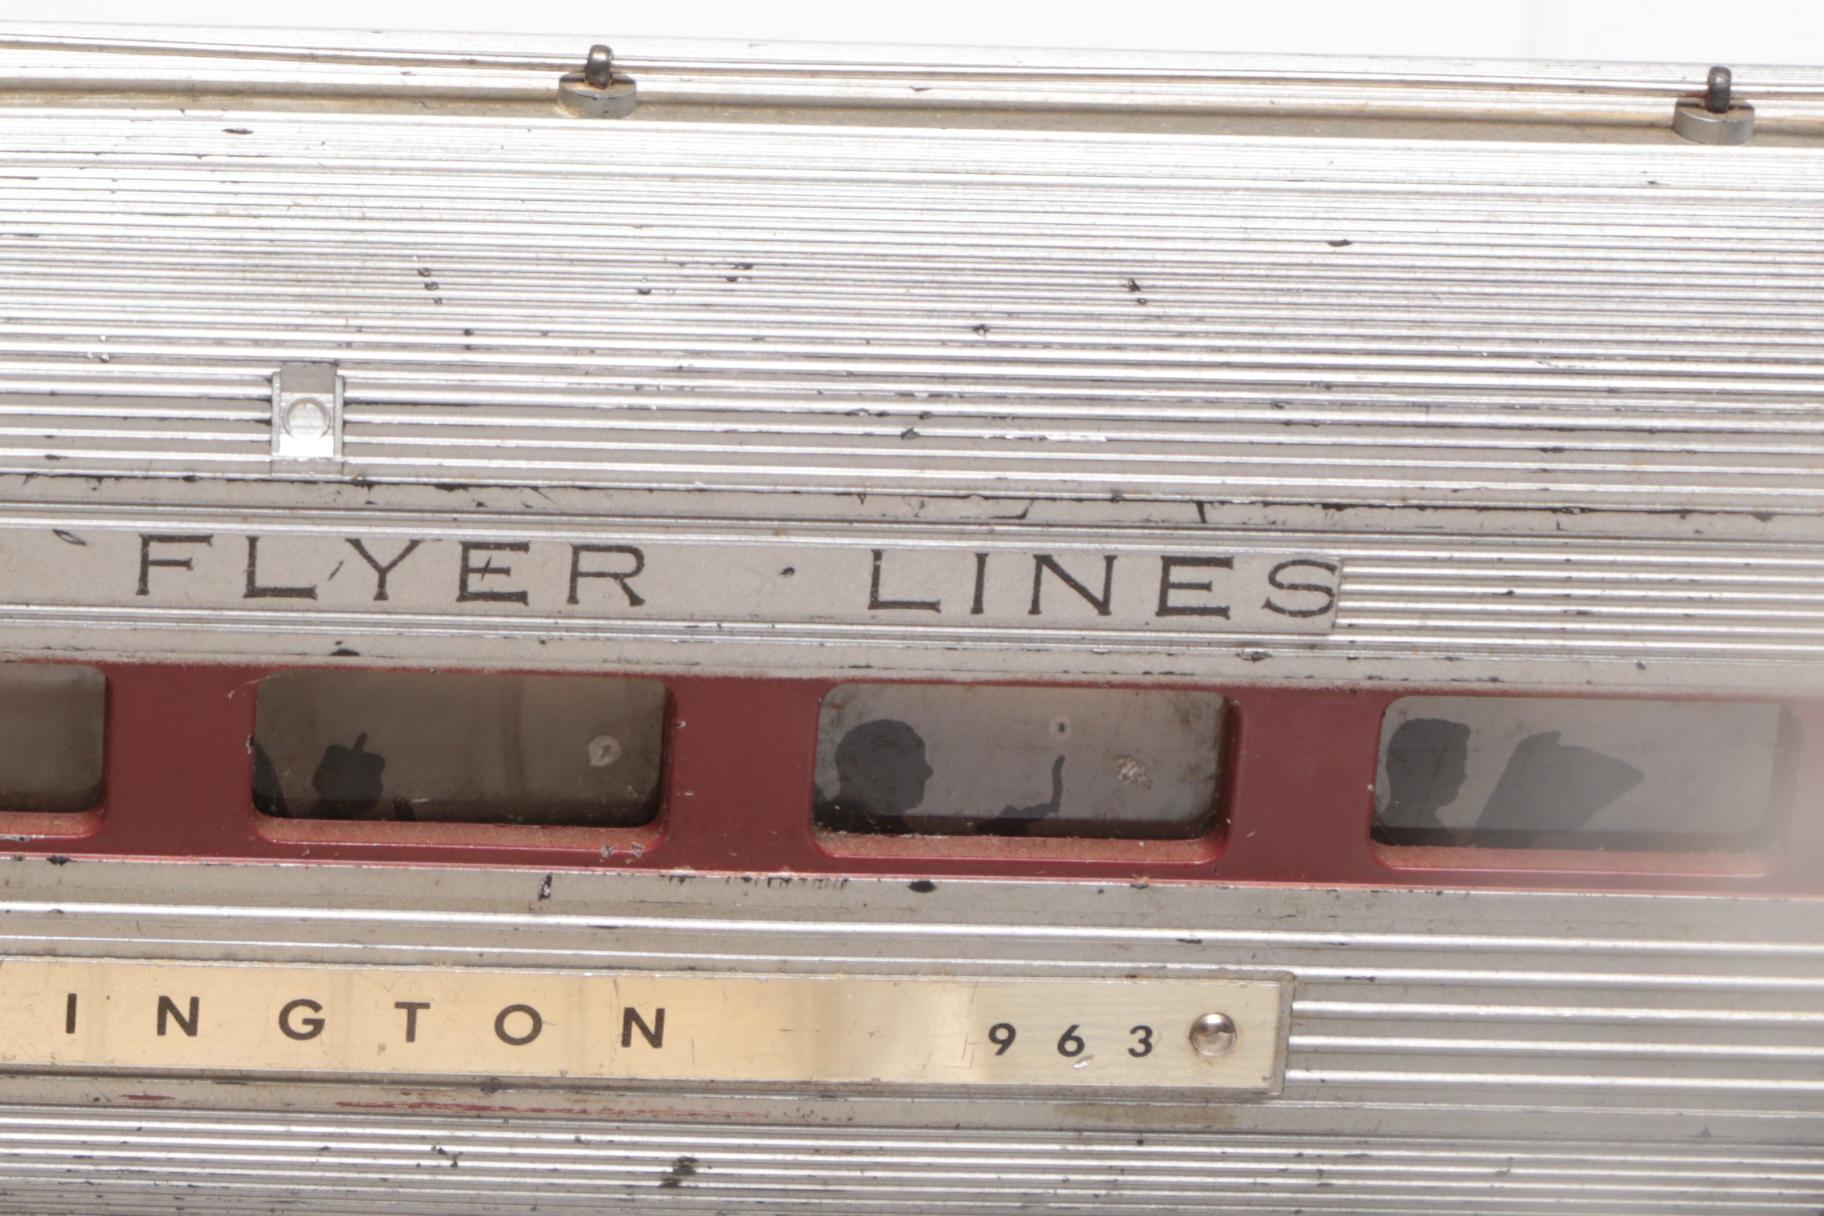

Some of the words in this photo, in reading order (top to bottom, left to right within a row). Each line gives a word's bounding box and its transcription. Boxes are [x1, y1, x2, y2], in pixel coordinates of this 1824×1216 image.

[135, 533, 647, 607] FLYER
[866, 548, 1339, 621] LINES
[987, 1021, 1155, 1059] 963
